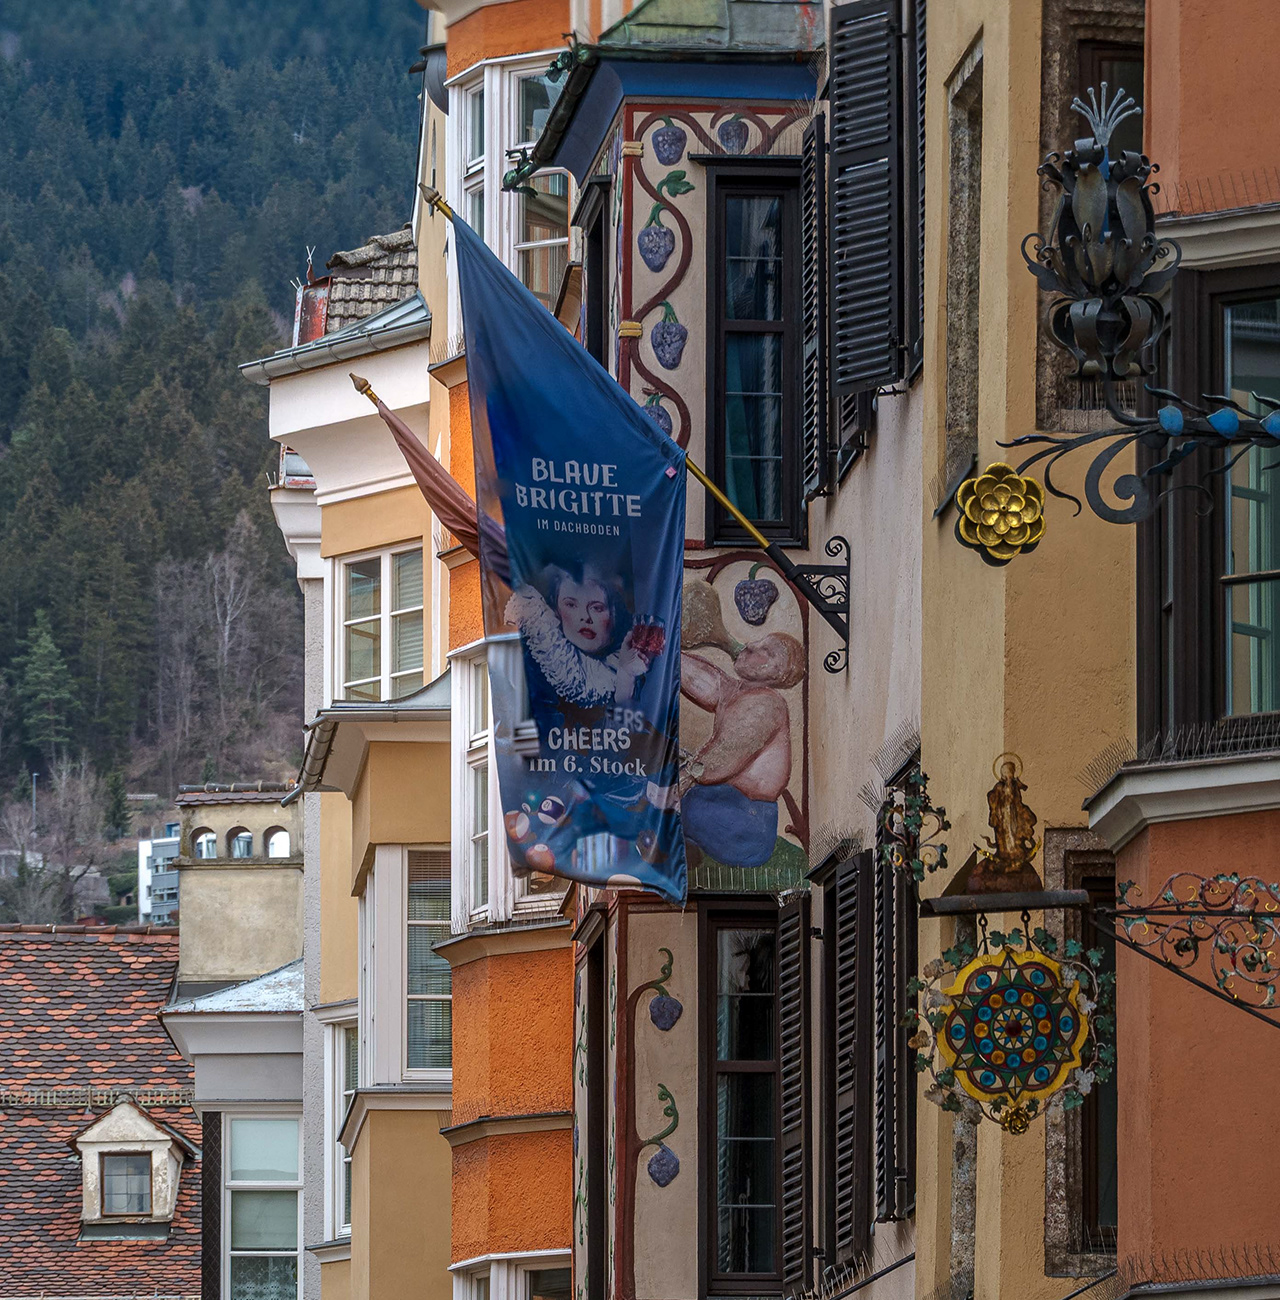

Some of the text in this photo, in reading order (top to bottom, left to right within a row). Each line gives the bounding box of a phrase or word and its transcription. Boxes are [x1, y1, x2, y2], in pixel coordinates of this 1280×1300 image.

[532, 457, 618, 487] BLAUE
[515, 483, 641, 516] BRIGITTE
[537, 519, 620, 536] IM DACHBODEN
[548, 727, 631, 752] CHEERS
[564, 755, 583, 773] 6.
[590, 756, 647, 777] Stock
